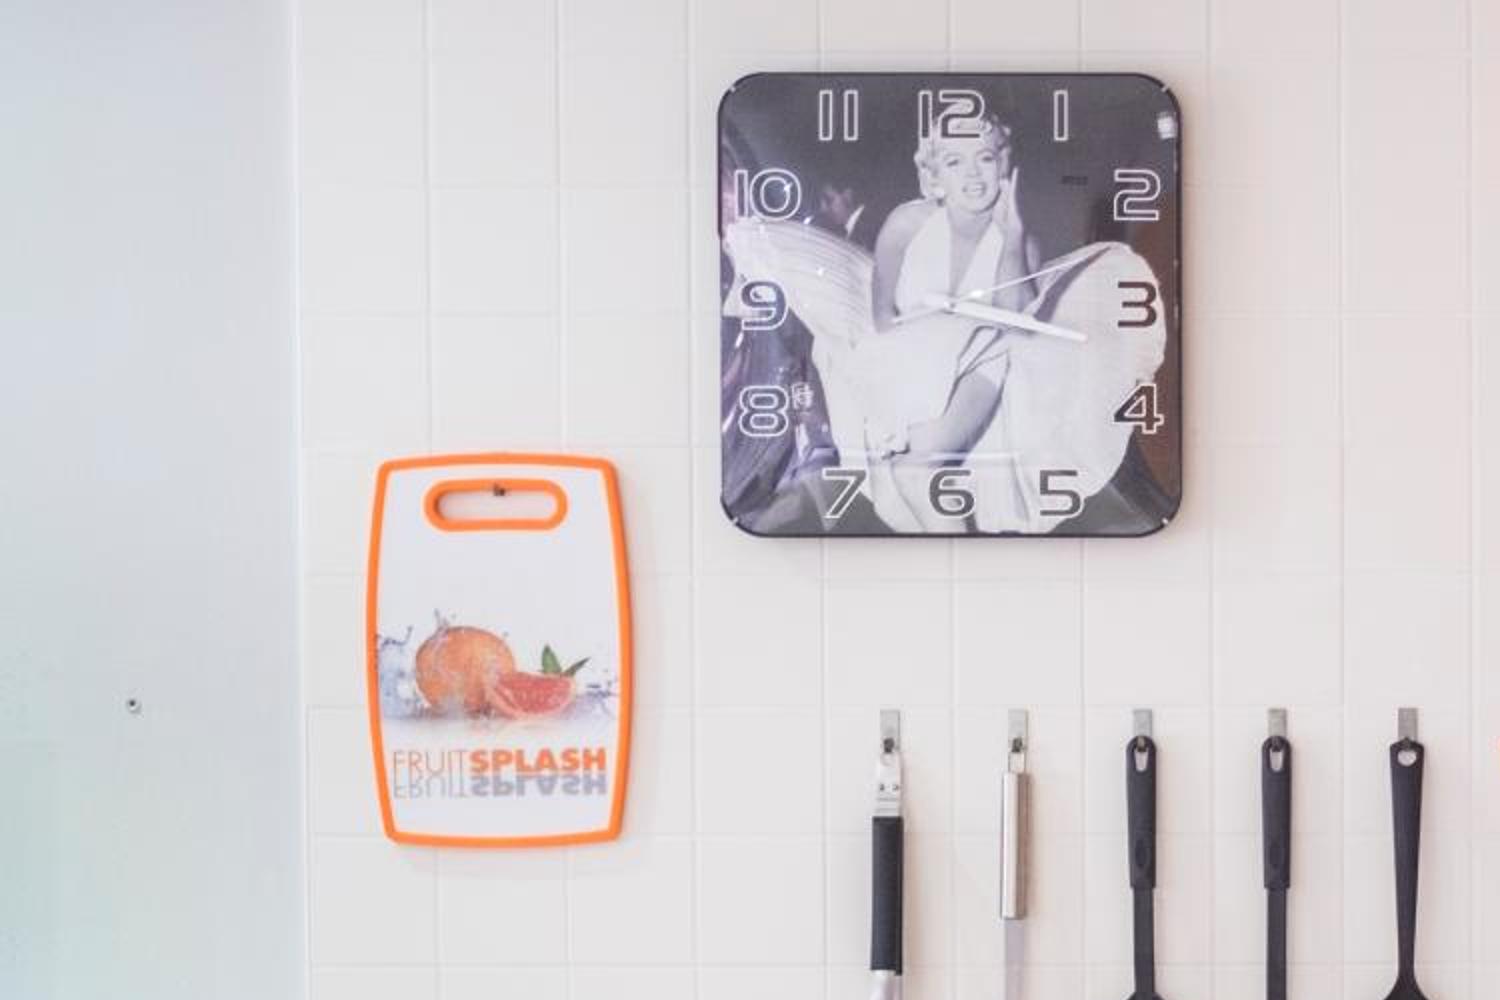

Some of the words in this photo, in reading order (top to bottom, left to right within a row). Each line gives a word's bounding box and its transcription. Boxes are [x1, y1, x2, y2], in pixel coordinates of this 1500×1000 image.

[817, 89, 859, 141] 11
[917, 89, 985, 139] 12
[1053, 89, 1069, 141] 1
[734, 168, 801, 221] 10
[1113, 168, 1161, 221] 2
[740, 281, 787, 331] 9
[1116, 281, 1157, 328] 3
[738, 385, 789, 437] 8
[1113, 383, 1164, 434] 4
[821, 468, 868, 518] 7
[928, 468, 976, 517] 6
[1038, 468, 1087, 517] 5
